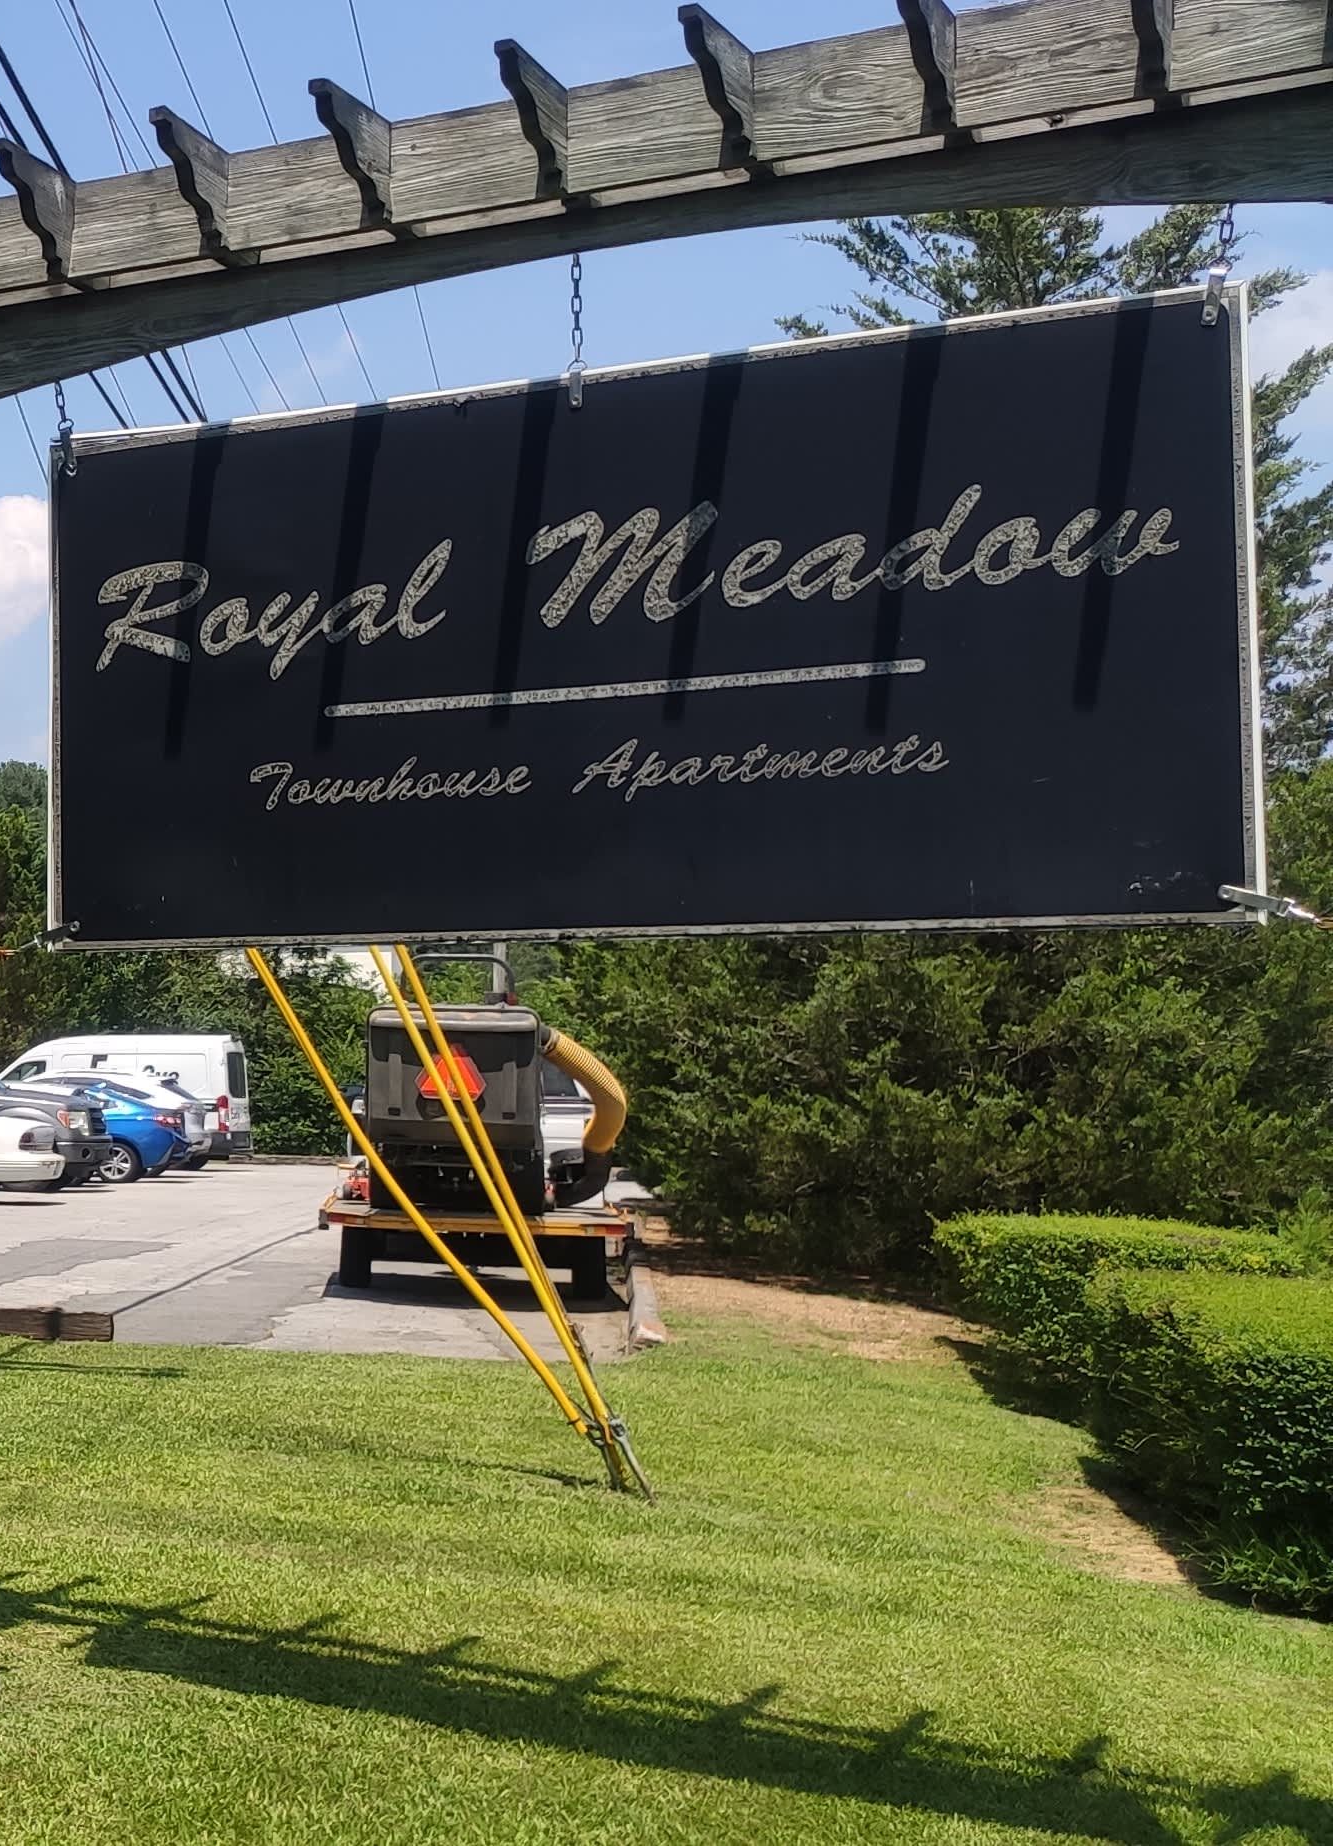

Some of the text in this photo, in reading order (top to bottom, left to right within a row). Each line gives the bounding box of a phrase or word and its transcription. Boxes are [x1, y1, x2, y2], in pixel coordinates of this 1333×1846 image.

[94, 482, 1181, 682] Royal Meadow
[248, 733, 951, 812] Townhouse Apartments
